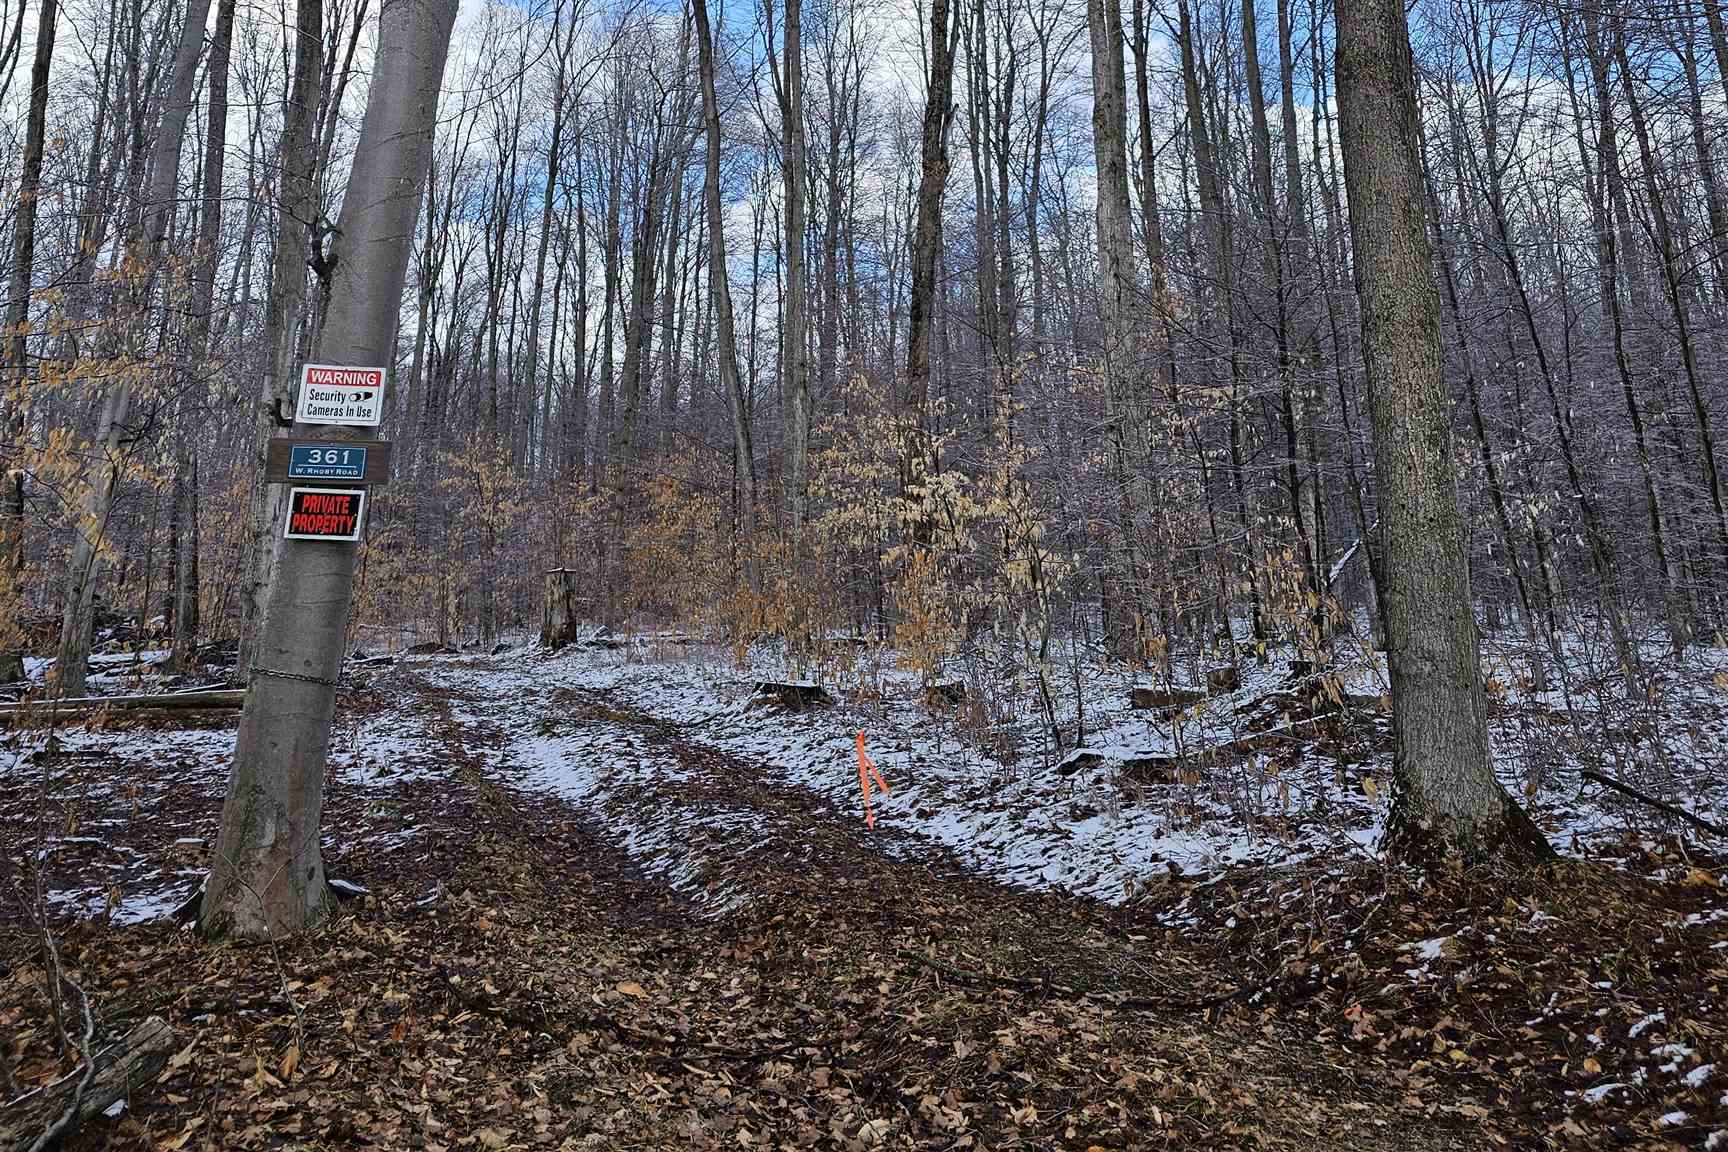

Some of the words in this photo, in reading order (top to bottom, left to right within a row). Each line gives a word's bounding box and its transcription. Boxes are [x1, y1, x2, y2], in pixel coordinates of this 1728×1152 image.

[311, 370, 377, 385] WARNING
[309, 389, 346, 404] Security
[307, 403, 344, 417] Cameras
[346, 405, 354, 417] In
[356, 405, 372, 418] Use
[308, 449, 350, 465] 361
[295, 467, 305, 475] W.
[336, 468, 358, 476] ROAD
[302, 494, 351, 514] PRIVATE
[291, 513, 354, 534] PROPERTY
